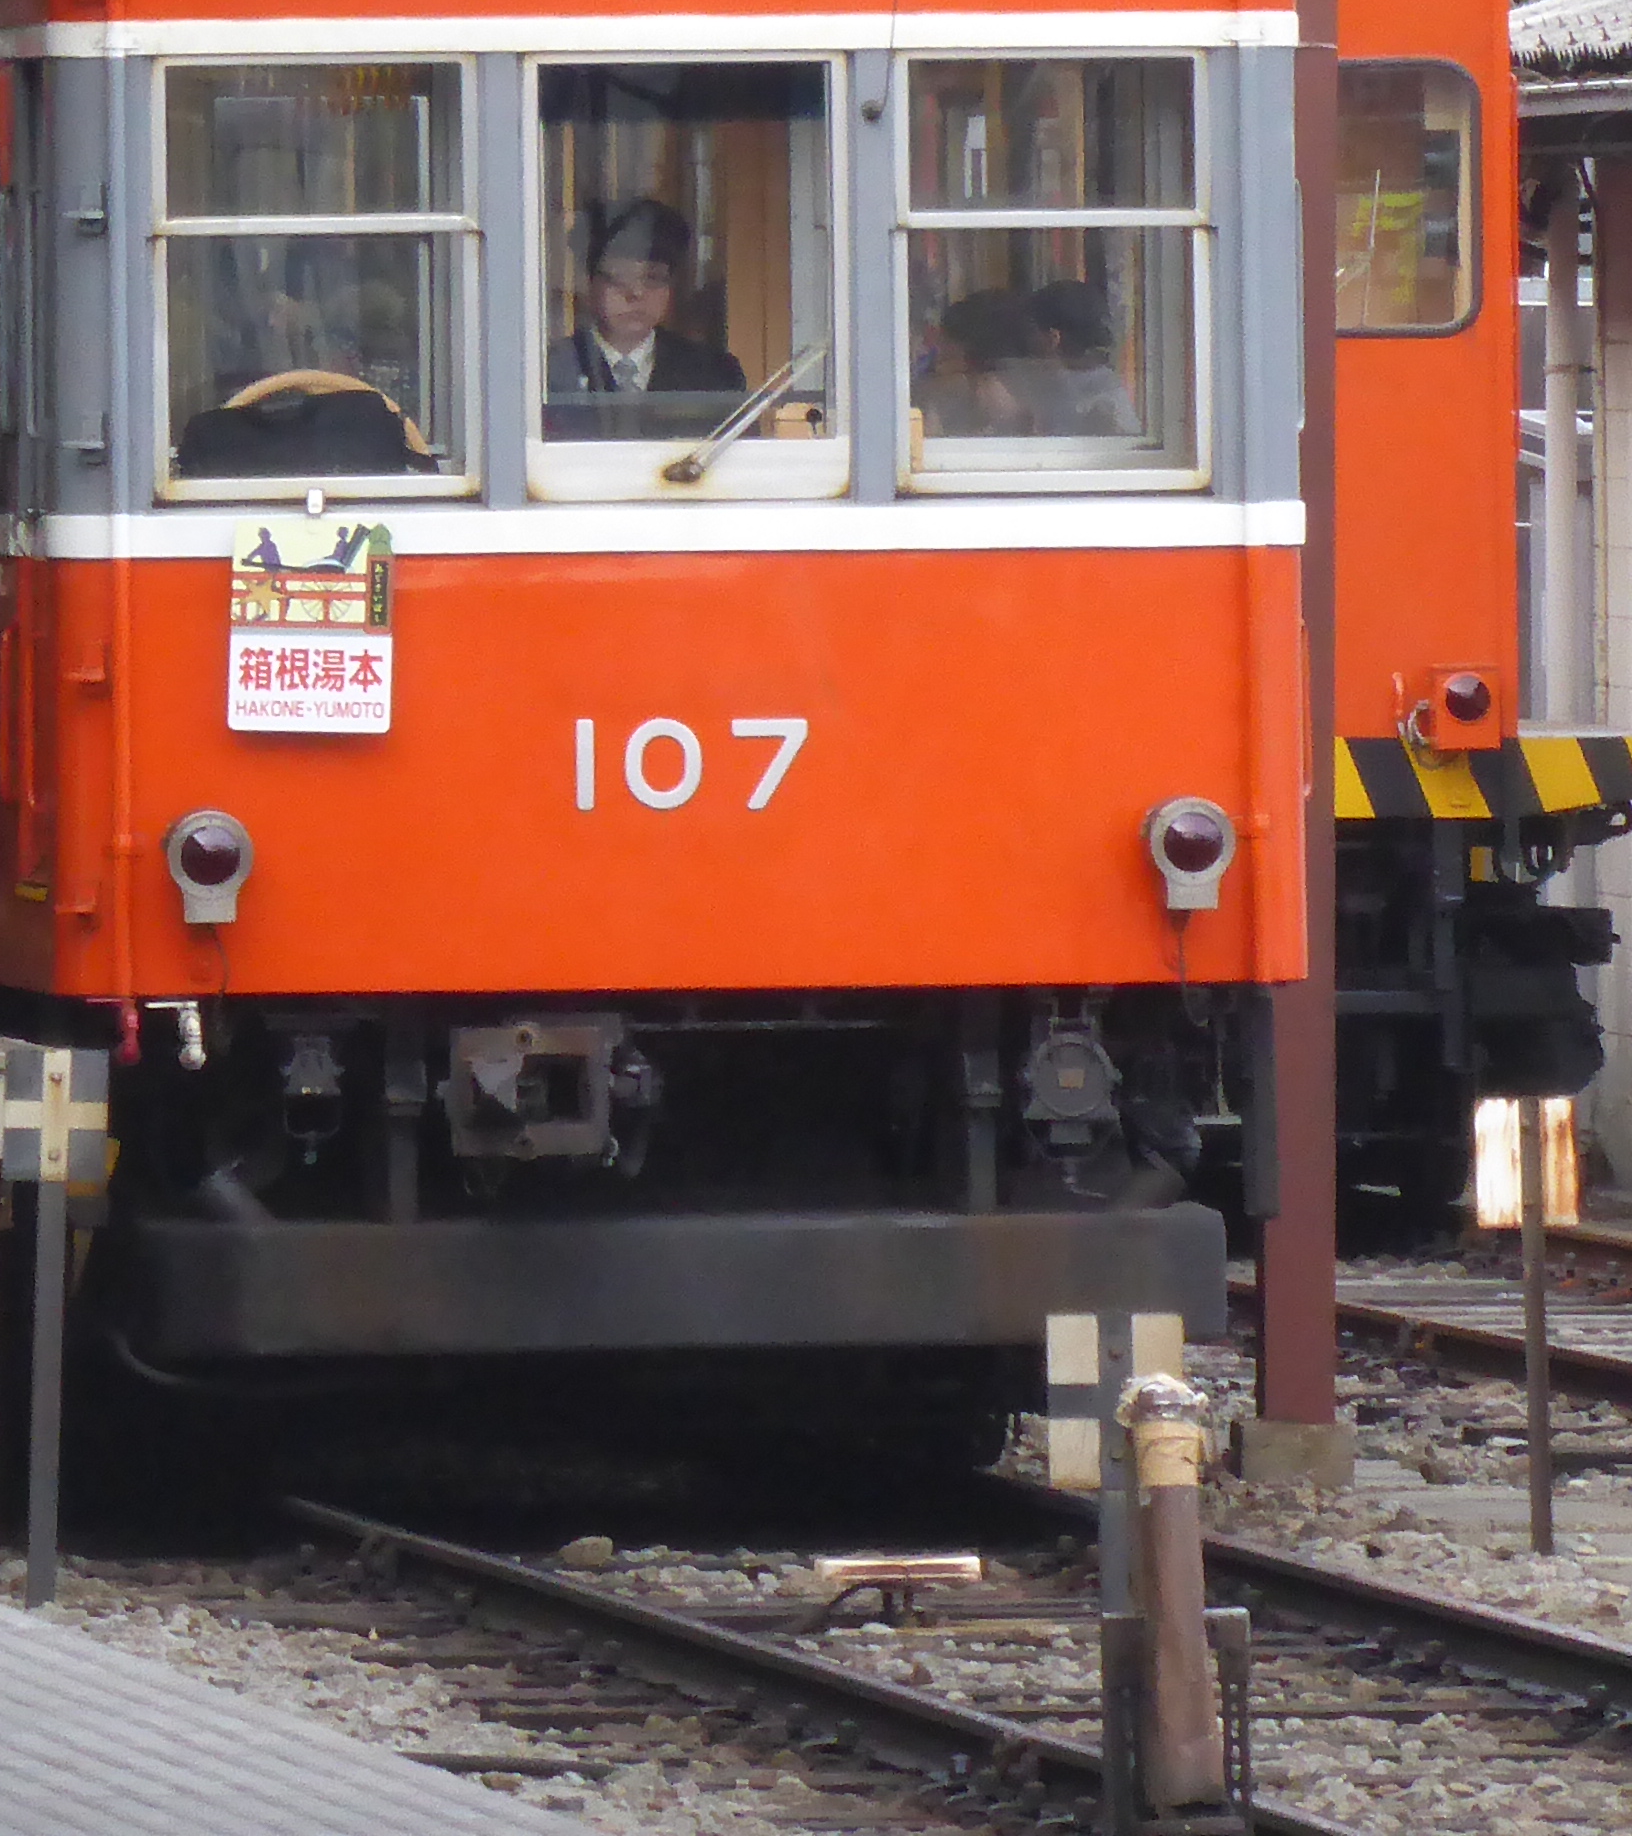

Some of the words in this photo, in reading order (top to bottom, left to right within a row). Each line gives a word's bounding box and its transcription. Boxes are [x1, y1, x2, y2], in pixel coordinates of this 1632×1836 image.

[238, 647, 384, 693] 箱根湯本
[235, 700, 385, 719] HAKONE-YUMOTO
[575, 717, 809, 811] 107
